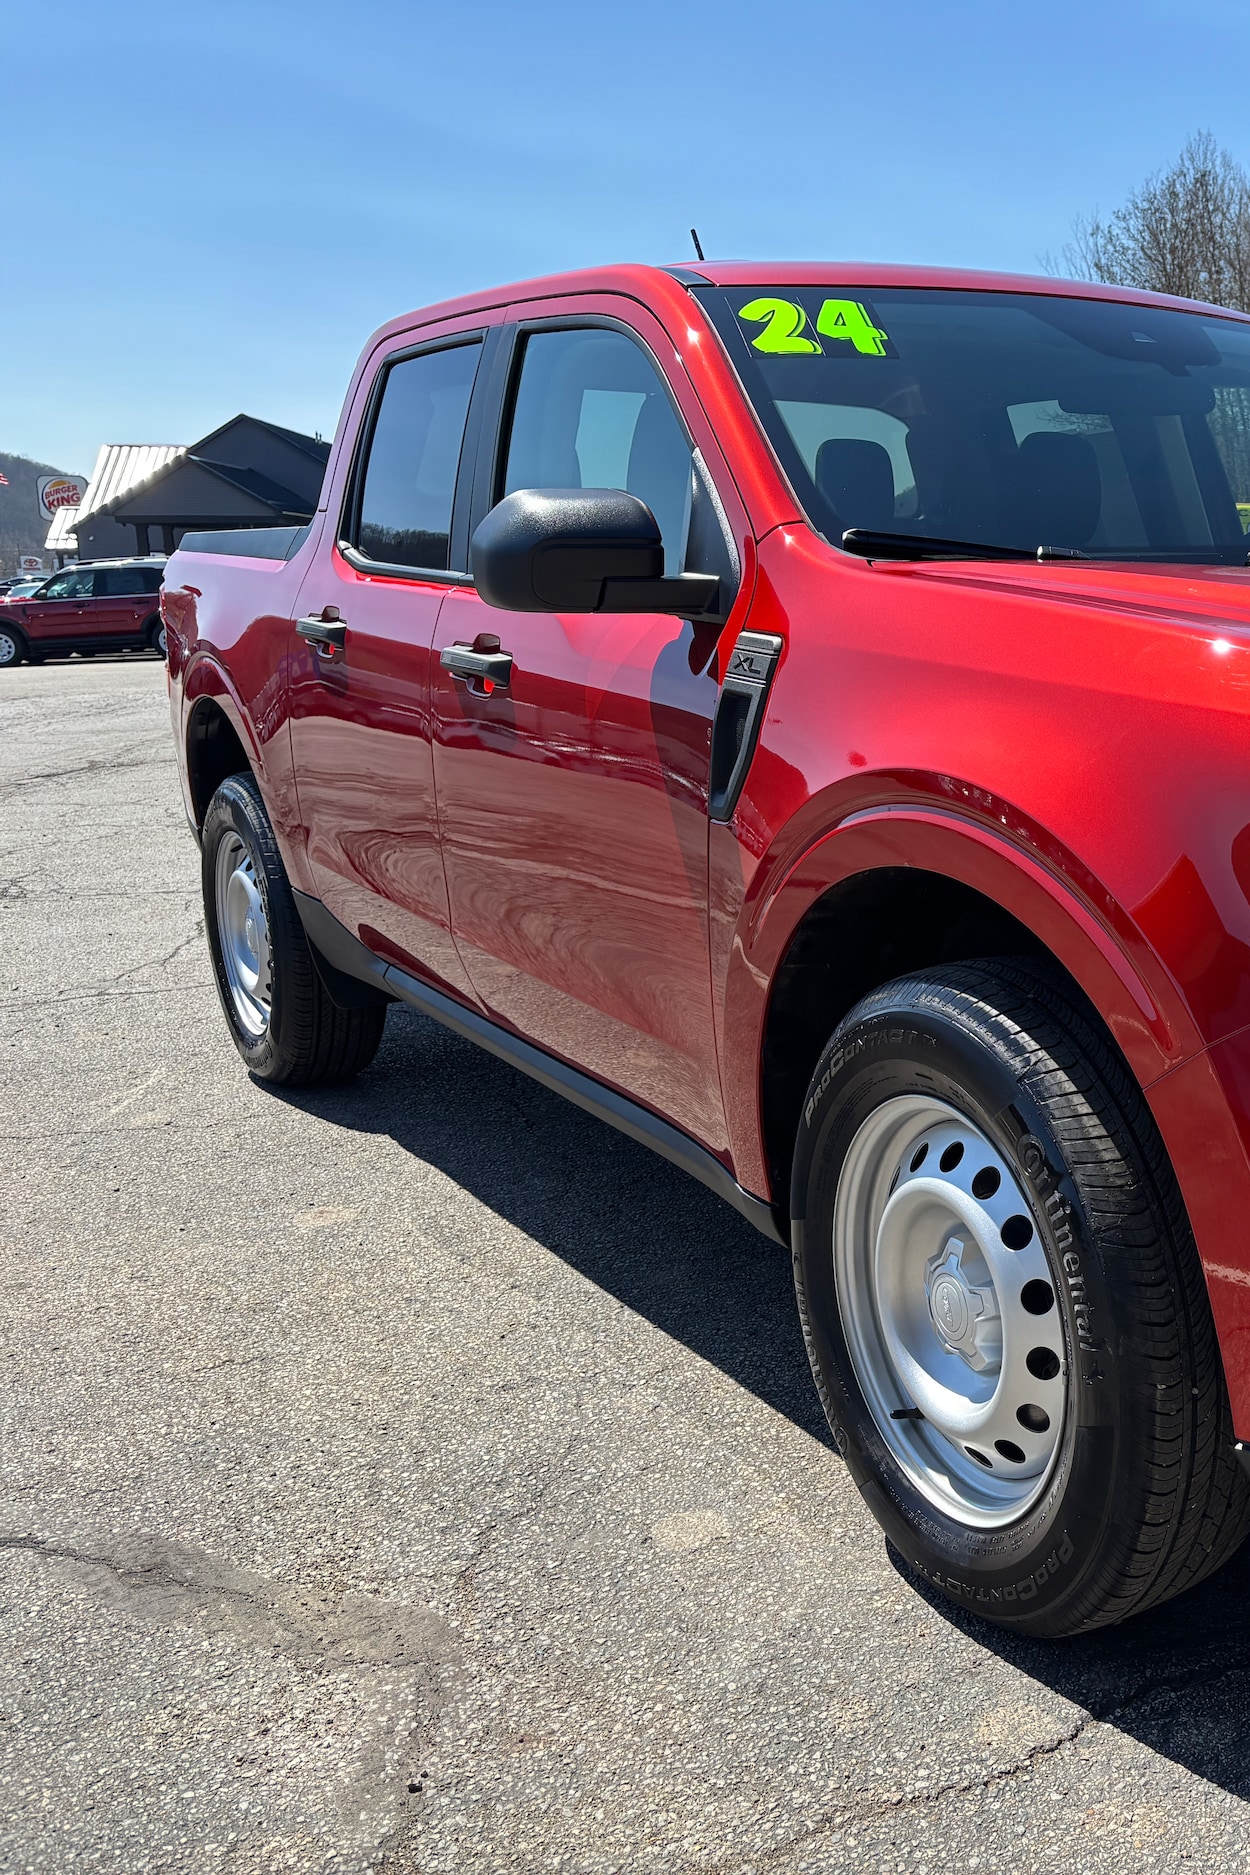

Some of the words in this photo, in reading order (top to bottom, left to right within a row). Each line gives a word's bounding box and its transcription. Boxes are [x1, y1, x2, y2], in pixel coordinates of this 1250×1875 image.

[738, 297, 888, 357] 24
[44, 484, 78, 500] BURGER
[47, 493, 81, 510] KING
[733, 653, 761, 675] XL
[1016, 1132, 1101, 1352] Continental
